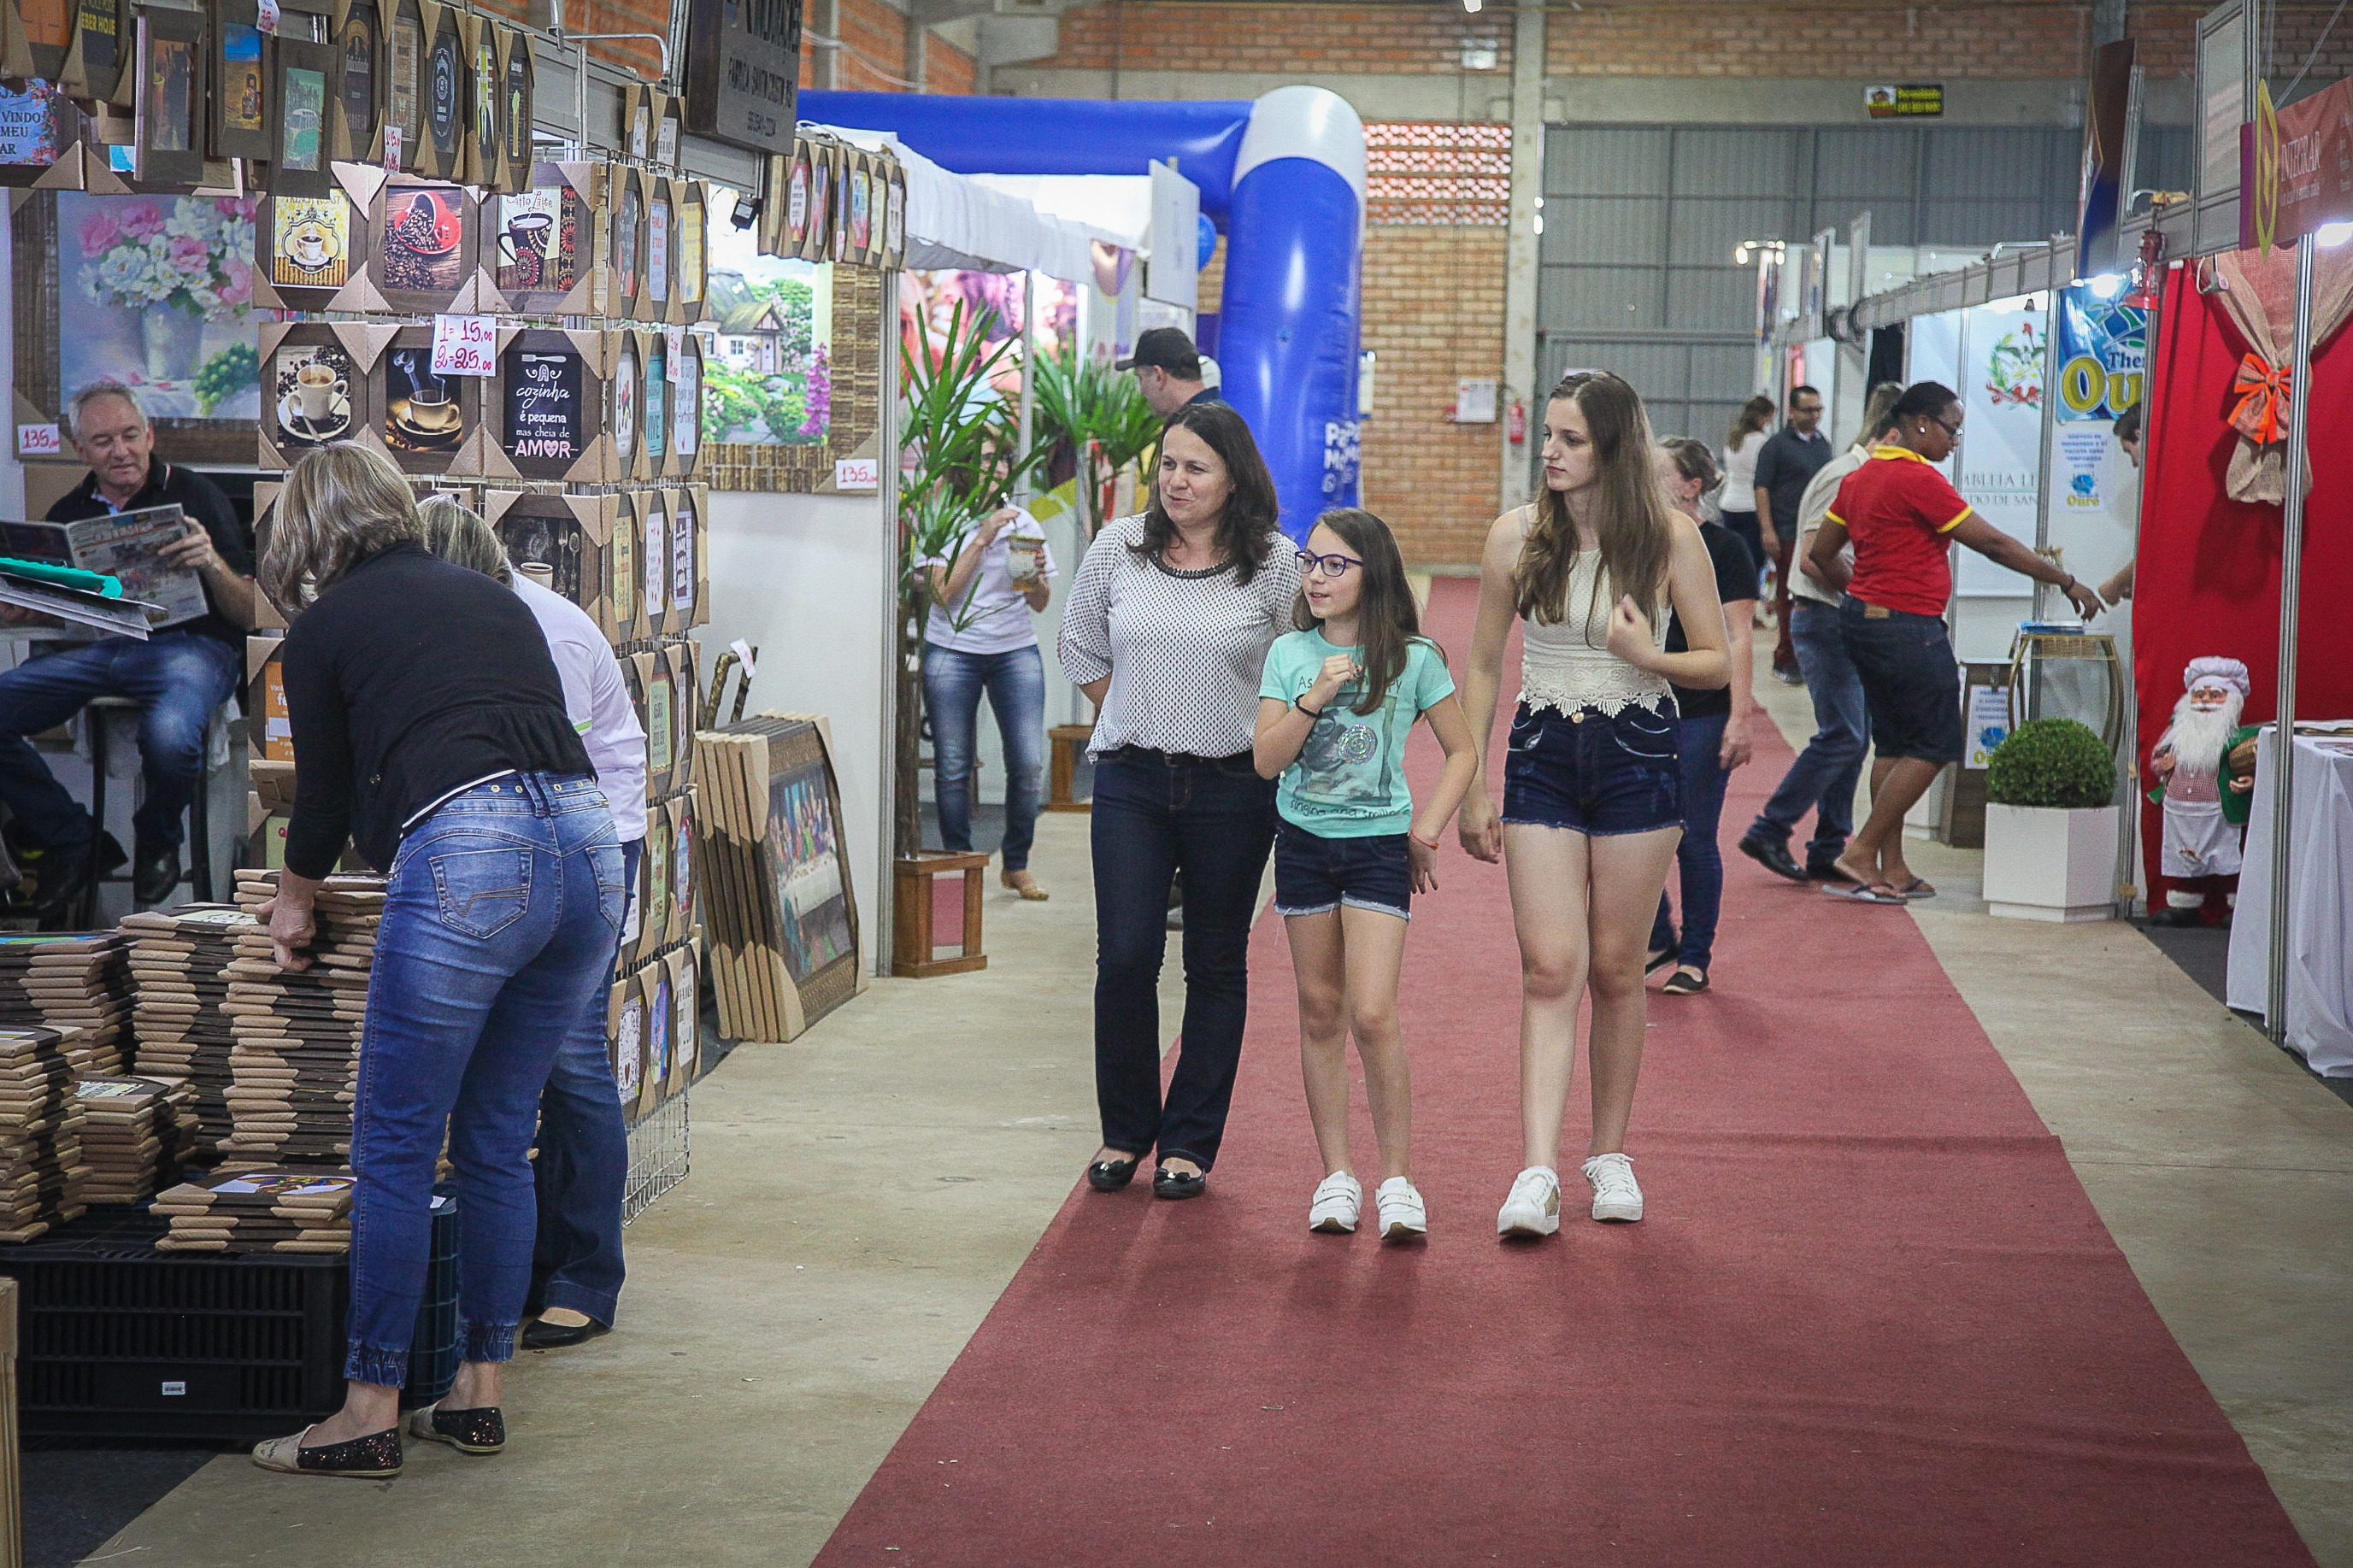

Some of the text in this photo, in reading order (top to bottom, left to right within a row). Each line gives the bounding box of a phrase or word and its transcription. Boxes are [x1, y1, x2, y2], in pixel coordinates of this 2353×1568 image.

[2, 111, 41, 124] VINDO
[537, 363, 550, 382] A
[2062, 356, 2144, 412] Ou
[515, 380, 570, 409] cozinha
[520, 410, 567, 426] é pequena
[534, 426, 556, 438] cheia
[559, 426, 570, 438] de
